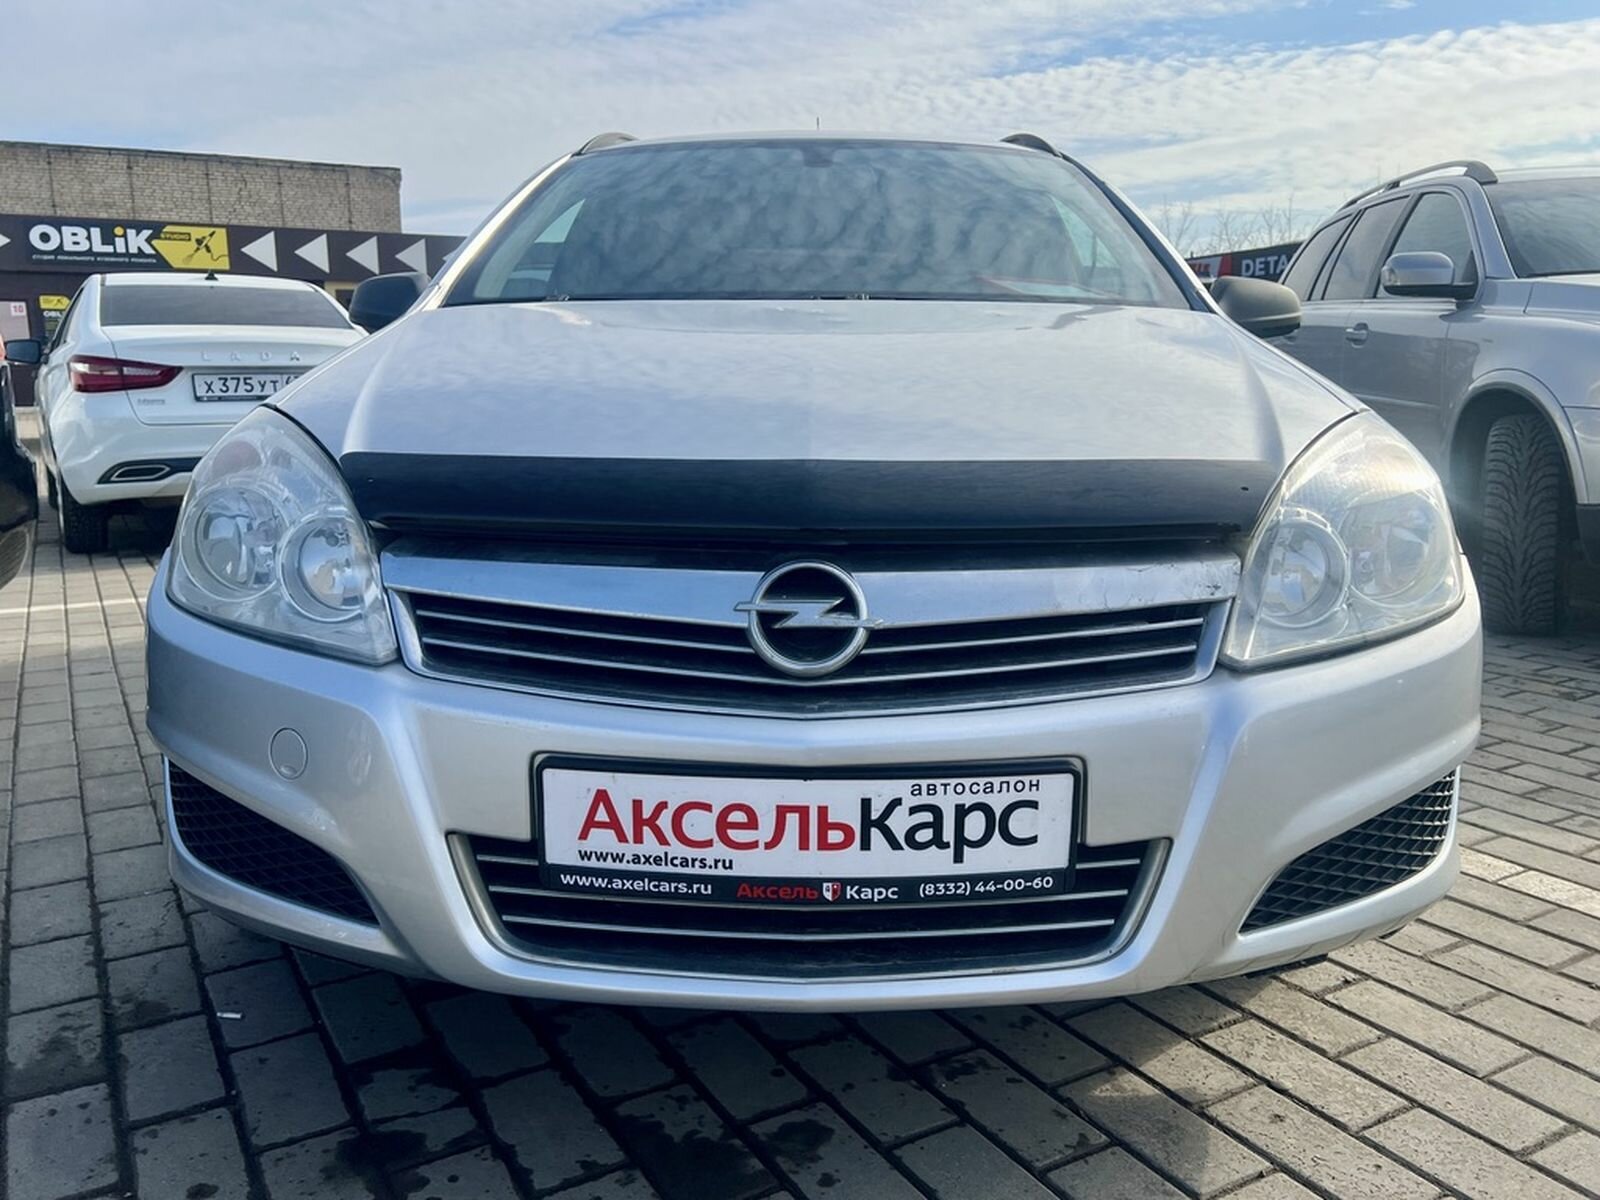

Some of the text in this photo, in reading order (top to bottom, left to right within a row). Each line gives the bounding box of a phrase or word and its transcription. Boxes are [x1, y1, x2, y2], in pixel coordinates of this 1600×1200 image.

[28, 224, 157, 255] OBLiK
[1241, 254, 1289, 276] DETA
[910, 779, 1040, 796] автосалон
[577, 788, 1040, 864] АксельКарс
[578, 849, 734, 870] www.axelcars.ru
[560, 873, 712, 895] www.axelcars.ru
[736, 883, 899, 901] Аксель Карс
[919, 876, 1054, 898] (8332) 44-00-60
